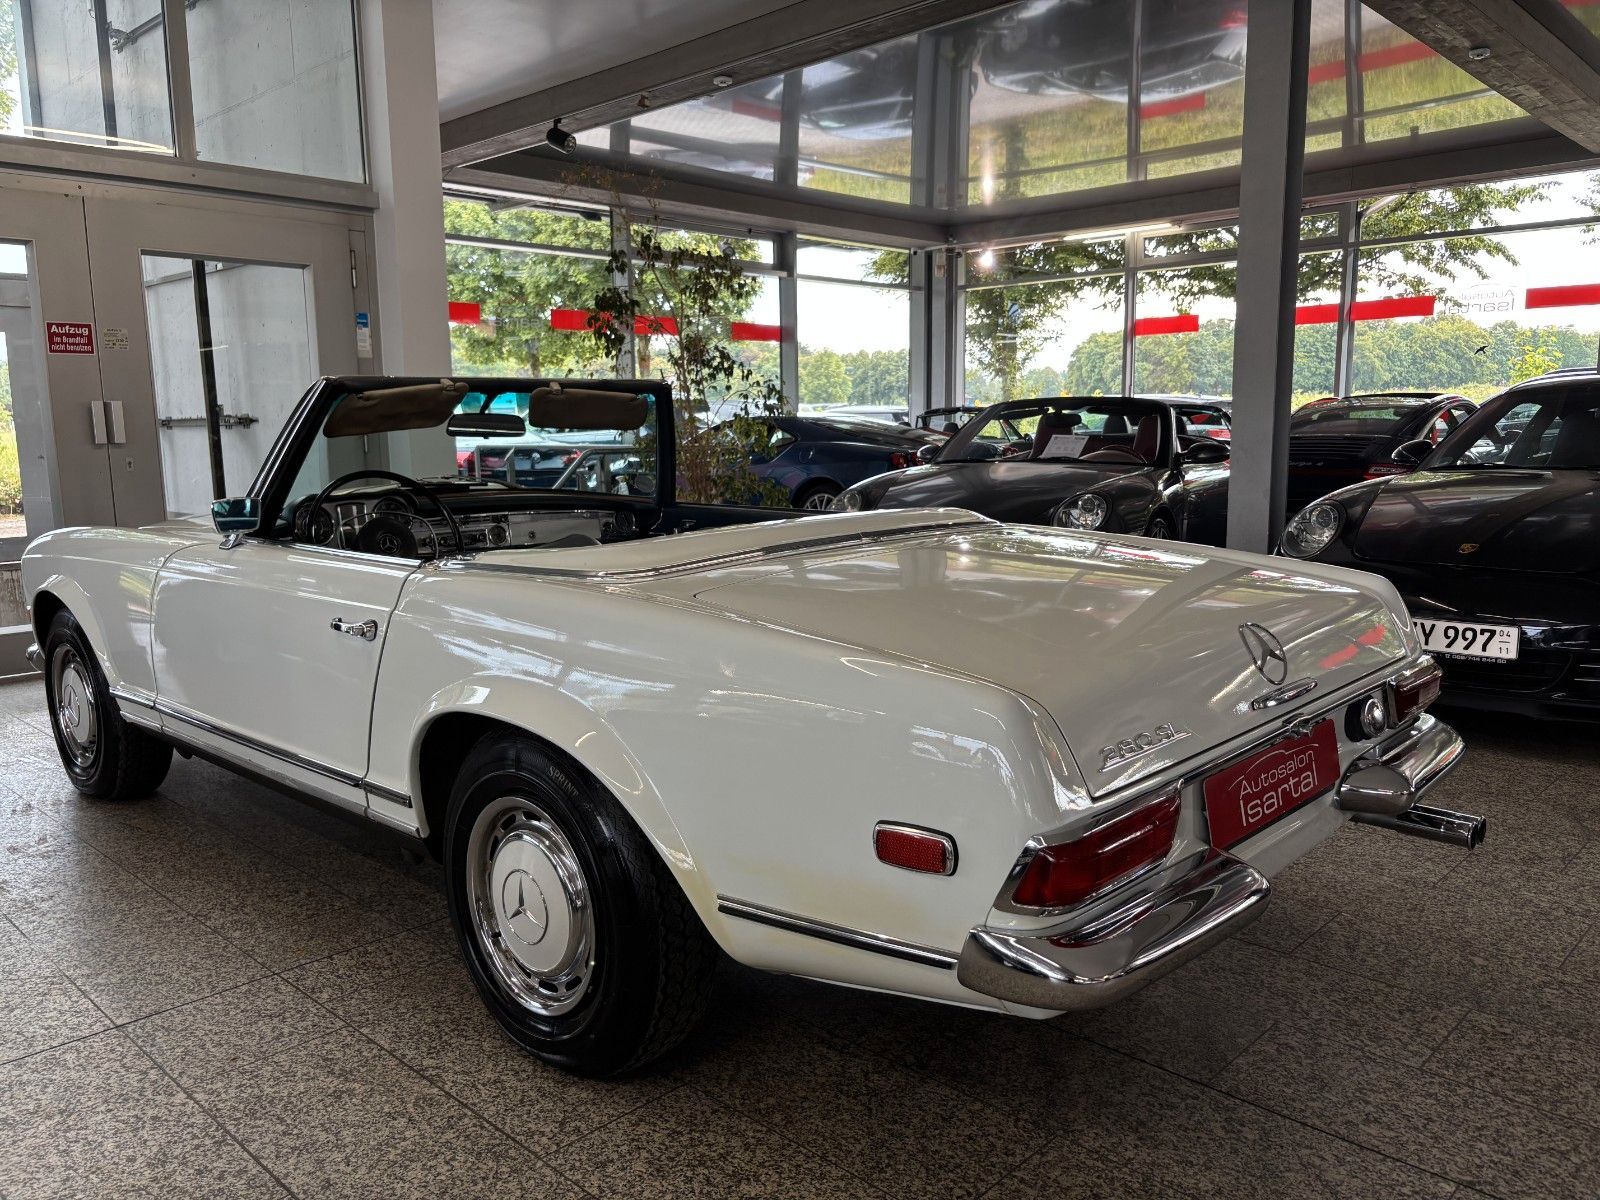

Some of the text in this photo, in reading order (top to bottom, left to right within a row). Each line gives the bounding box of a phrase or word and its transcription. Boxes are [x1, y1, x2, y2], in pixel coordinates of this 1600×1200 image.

[51, 325, 88, 335] Aufzug
[51, 343, 92, 352] nicht benutzen
[62, 336, 88, 344] Brandfall
[1443, 625, 1497, 653] 997
[1498, 629, 1511, 638] 04
[1498, 646, 1510, 655] 11
[1099, 722, 1188, 767] 280 SL
[548, 765, 579, 796] SPRINT
[1239, 750, 1315, 800] Autosalon
[1239, 760, 1318, 827] Isartal
